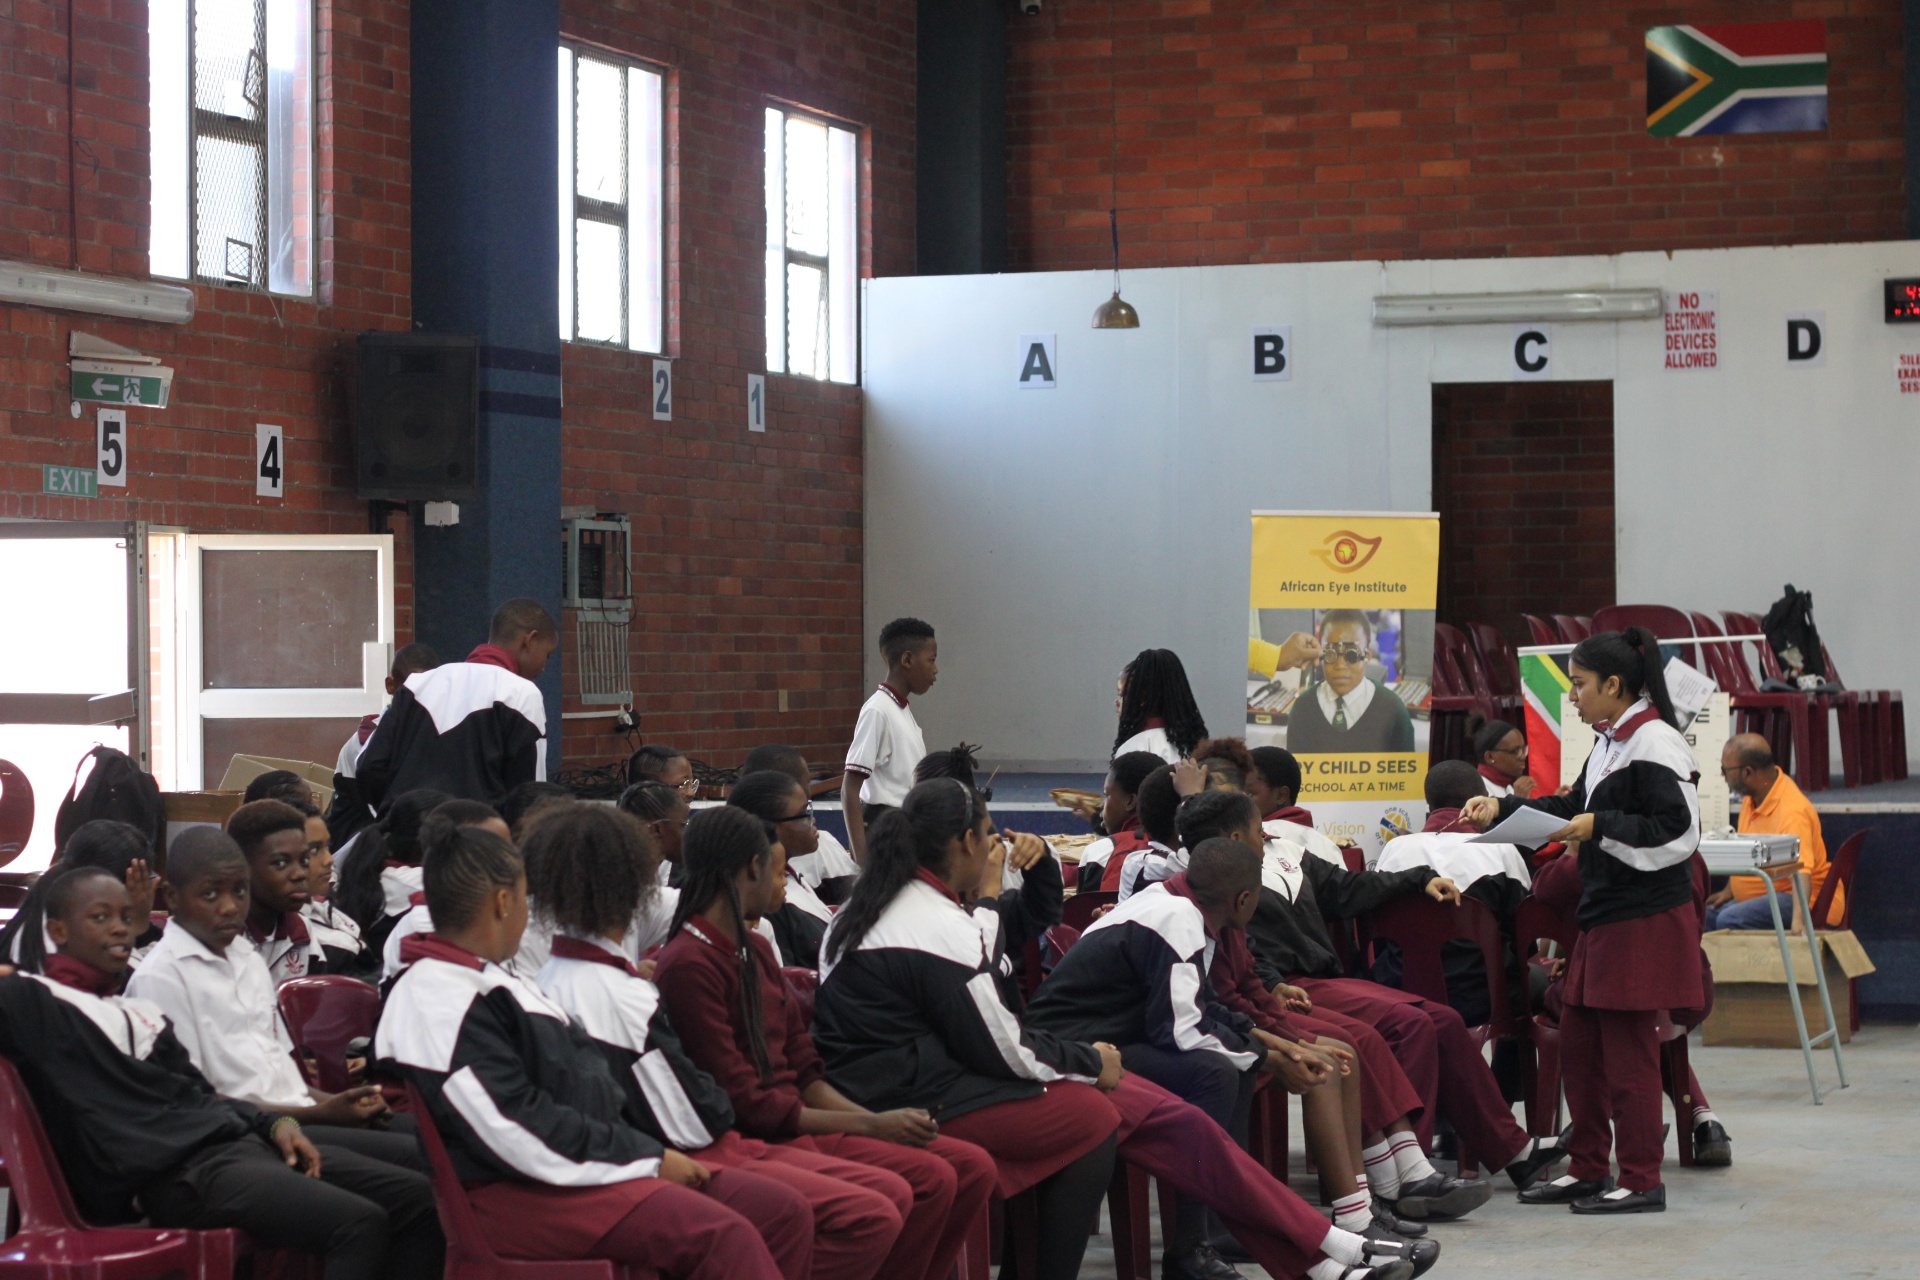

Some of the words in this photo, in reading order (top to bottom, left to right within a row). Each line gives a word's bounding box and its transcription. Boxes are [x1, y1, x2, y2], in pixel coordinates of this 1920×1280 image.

[1680, 292, 1699, 309] NO
[1665, 311, 1715, 331] ELECTRONIC
[1514, 331, 1548, 372] C
[1666, 333, 1716, 350] DEVICES
[1788, 319, 1821, 361] D
[1019, 342, 1054, 382] A
[1254, 334, 1286, 374] B
[1665, 352, 1717, 368] ALLOWED
[655, 369, 669, 413] 2
[751, 383, 760, 425] 1
[101, 421, 122, 477] 5
[260, 436, 280, 488] 4
[49, 468, 92, 494] EXIT
[1280, 581, 1325, 592] African
[1329, 582, 1350, 596] Eye
[1354, 582, 1407, 593] Institute
[1319, 761, 1371, 774] CHILD
[1377, 760, 1417, 773] SEES
[1349, 782, 1364, 791] AT
[1367, 782, 1375, 791] A
[1379, 782, 1405, 791] TIME
[1323, 821, 1366, 836] Vision
